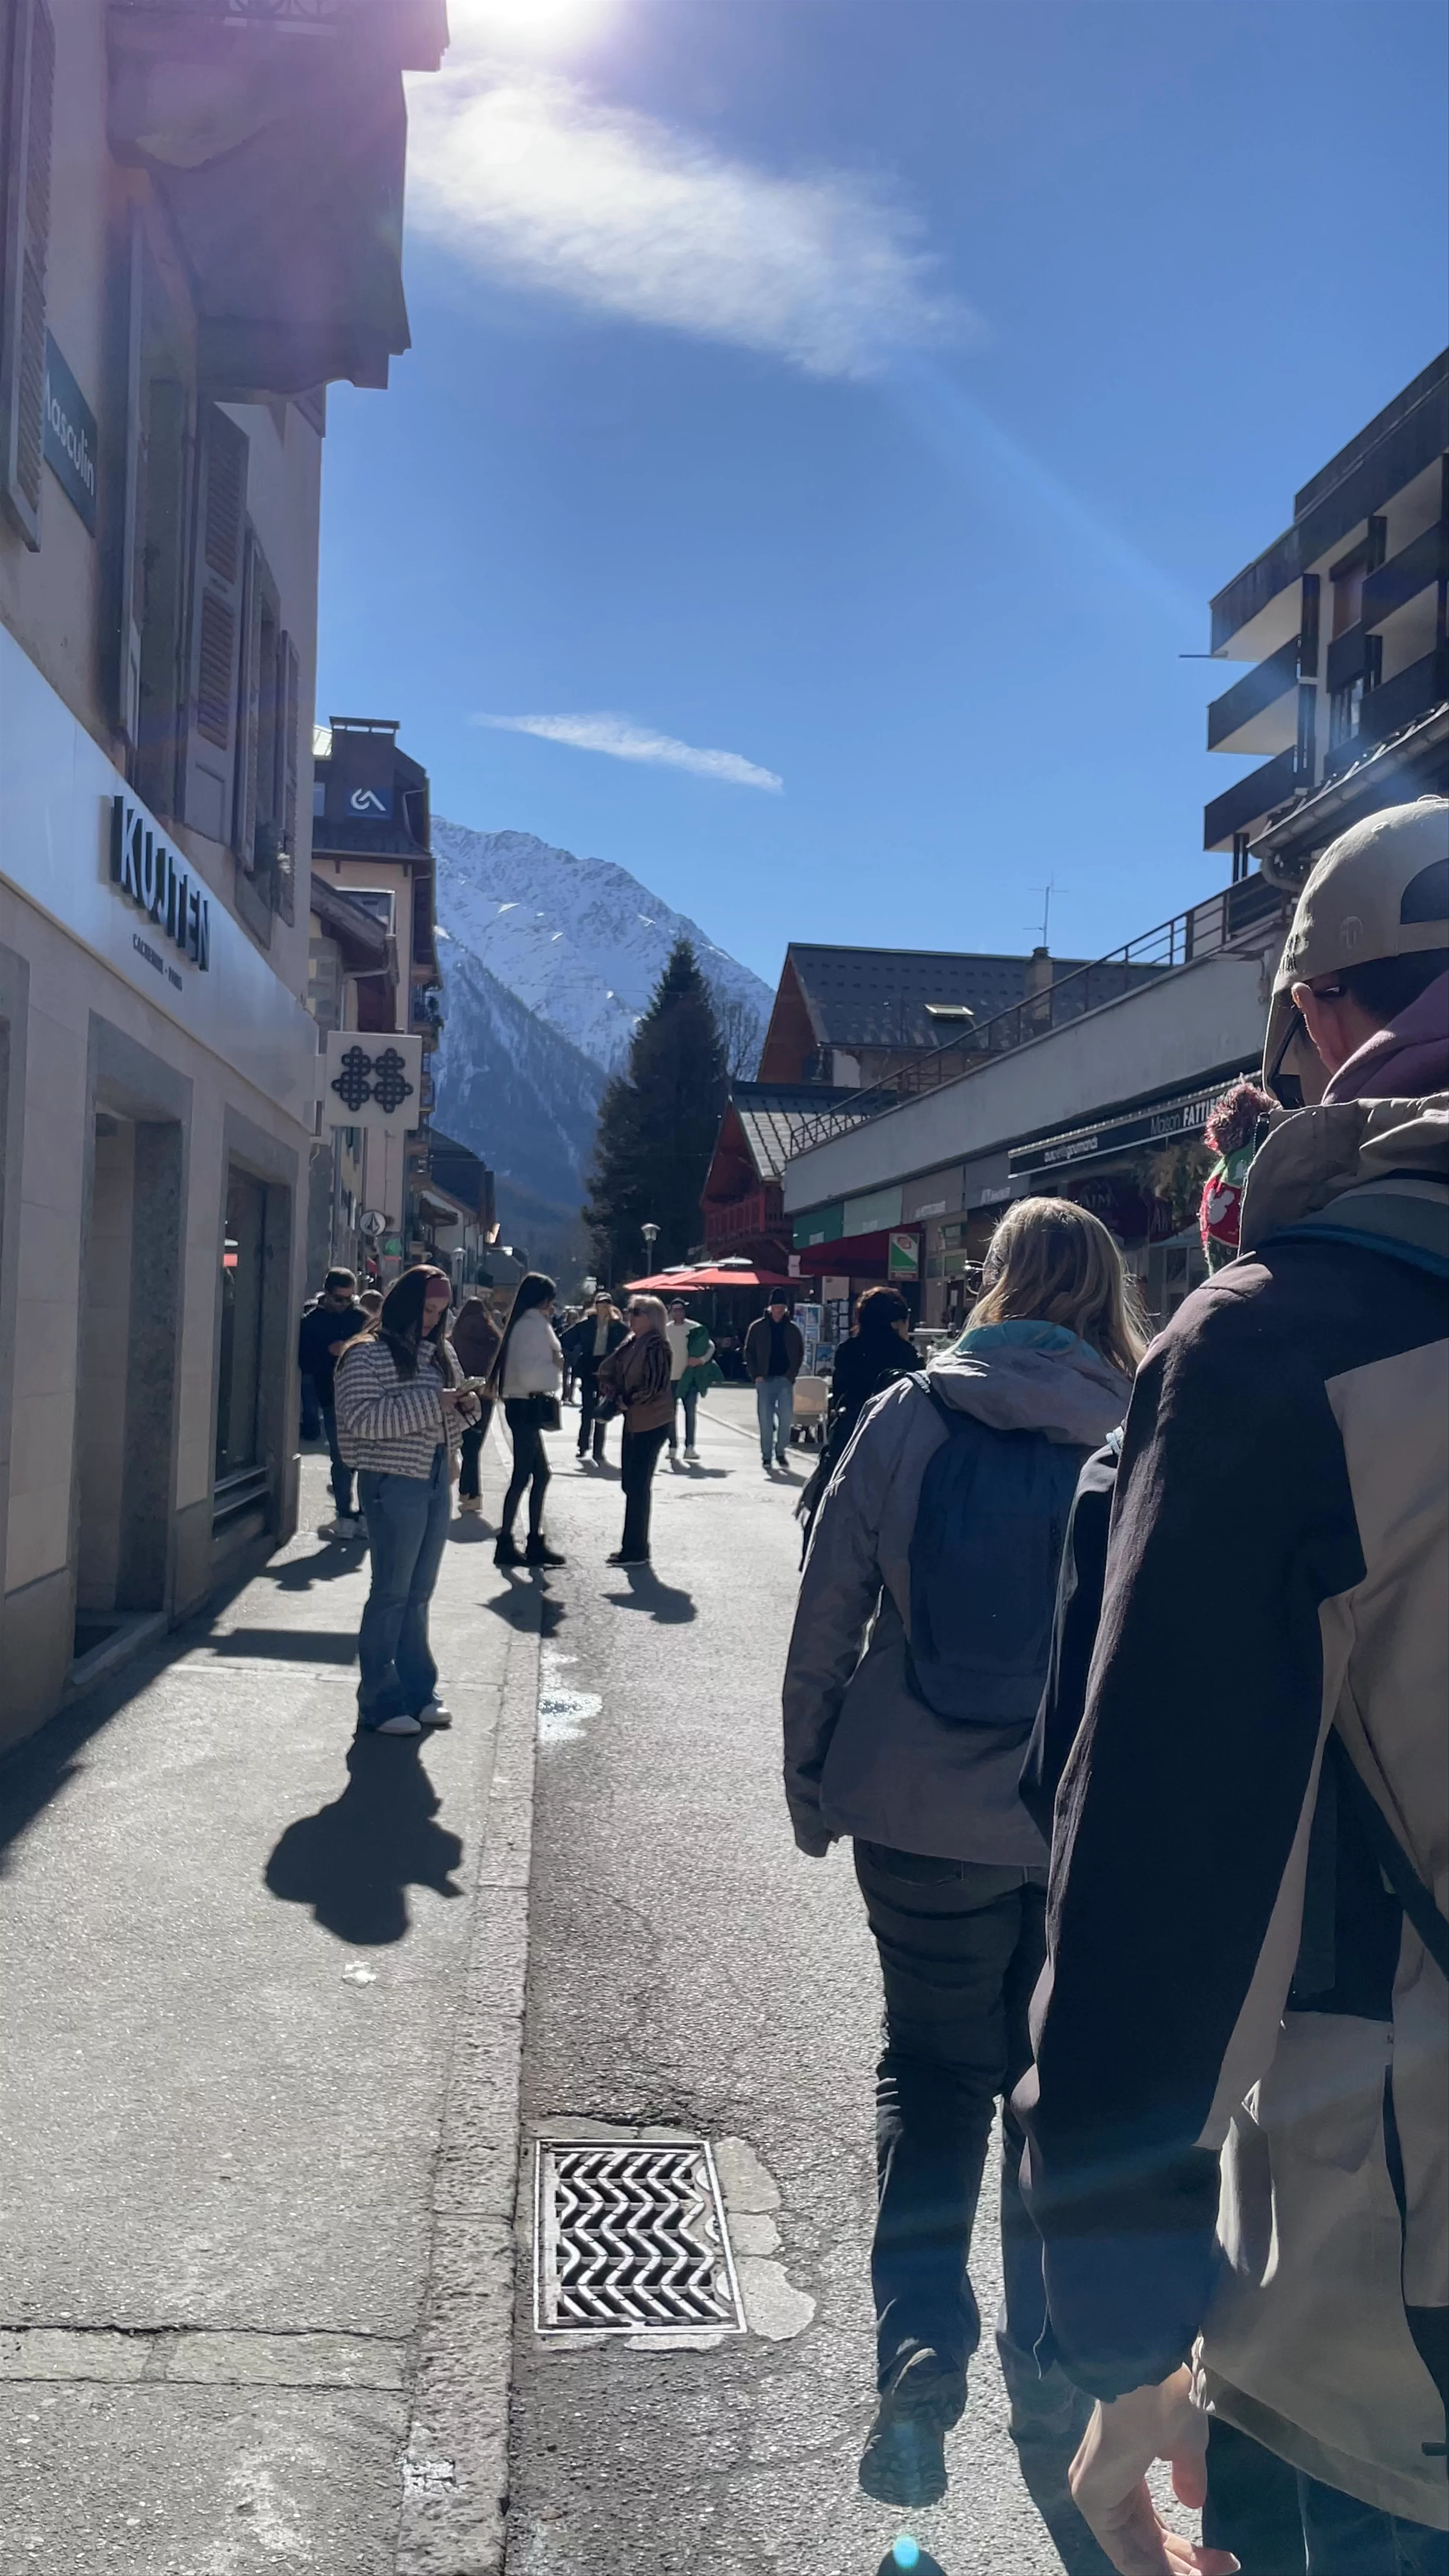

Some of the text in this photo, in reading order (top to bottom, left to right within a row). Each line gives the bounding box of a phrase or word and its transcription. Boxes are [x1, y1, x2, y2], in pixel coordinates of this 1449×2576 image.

[47, 371, 94, 497] asculin
[111, 795, 211, 972] KUJTEN
[1151, 1114, 1181, 1135] Maison
